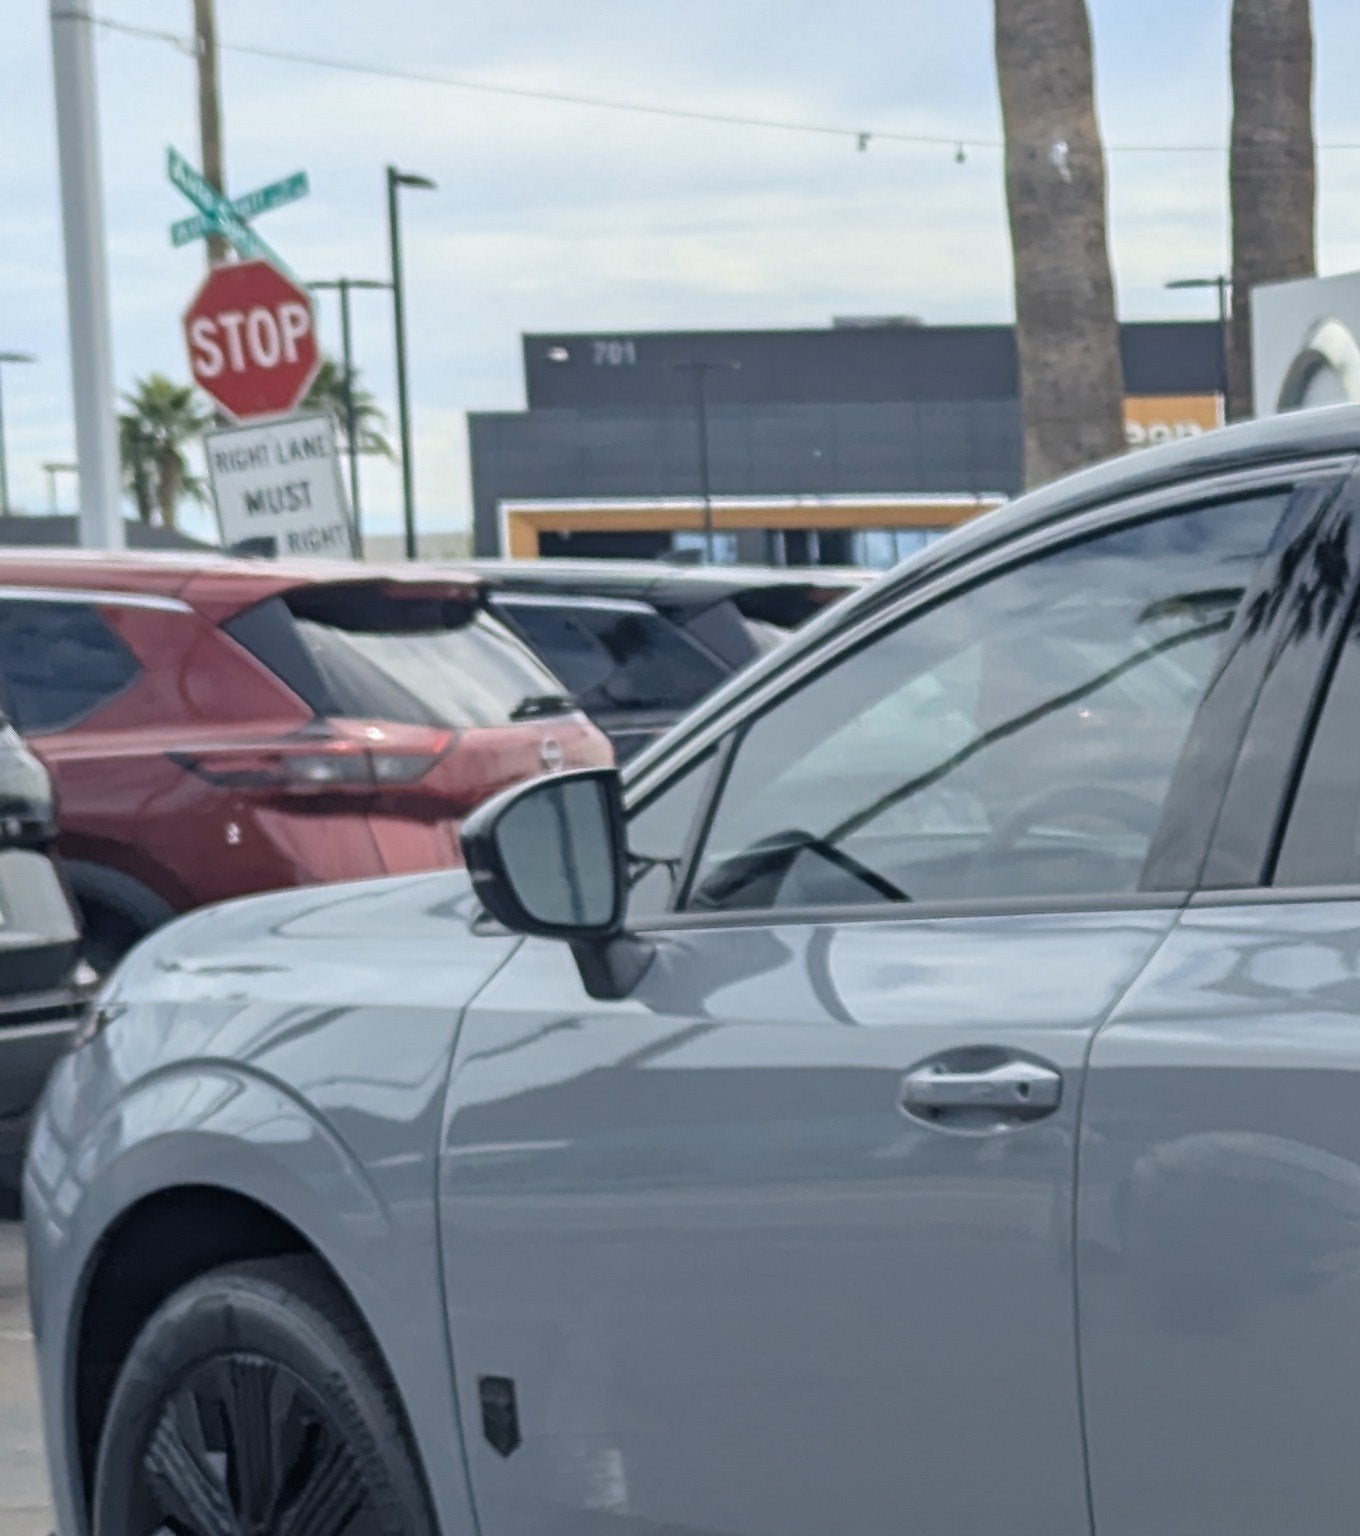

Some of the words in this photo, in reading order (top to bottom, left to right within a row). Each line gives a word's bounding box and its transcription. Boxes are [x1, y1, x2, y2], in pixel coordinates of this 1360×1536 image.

[190, 302, 310, 378] STOP
[215, 443, 269, 473] RIGHT
[276, 435, 327, 464] LANE
[244, 480, 312, 516] MUST
[287, 523, 346, 553] RIGHT
